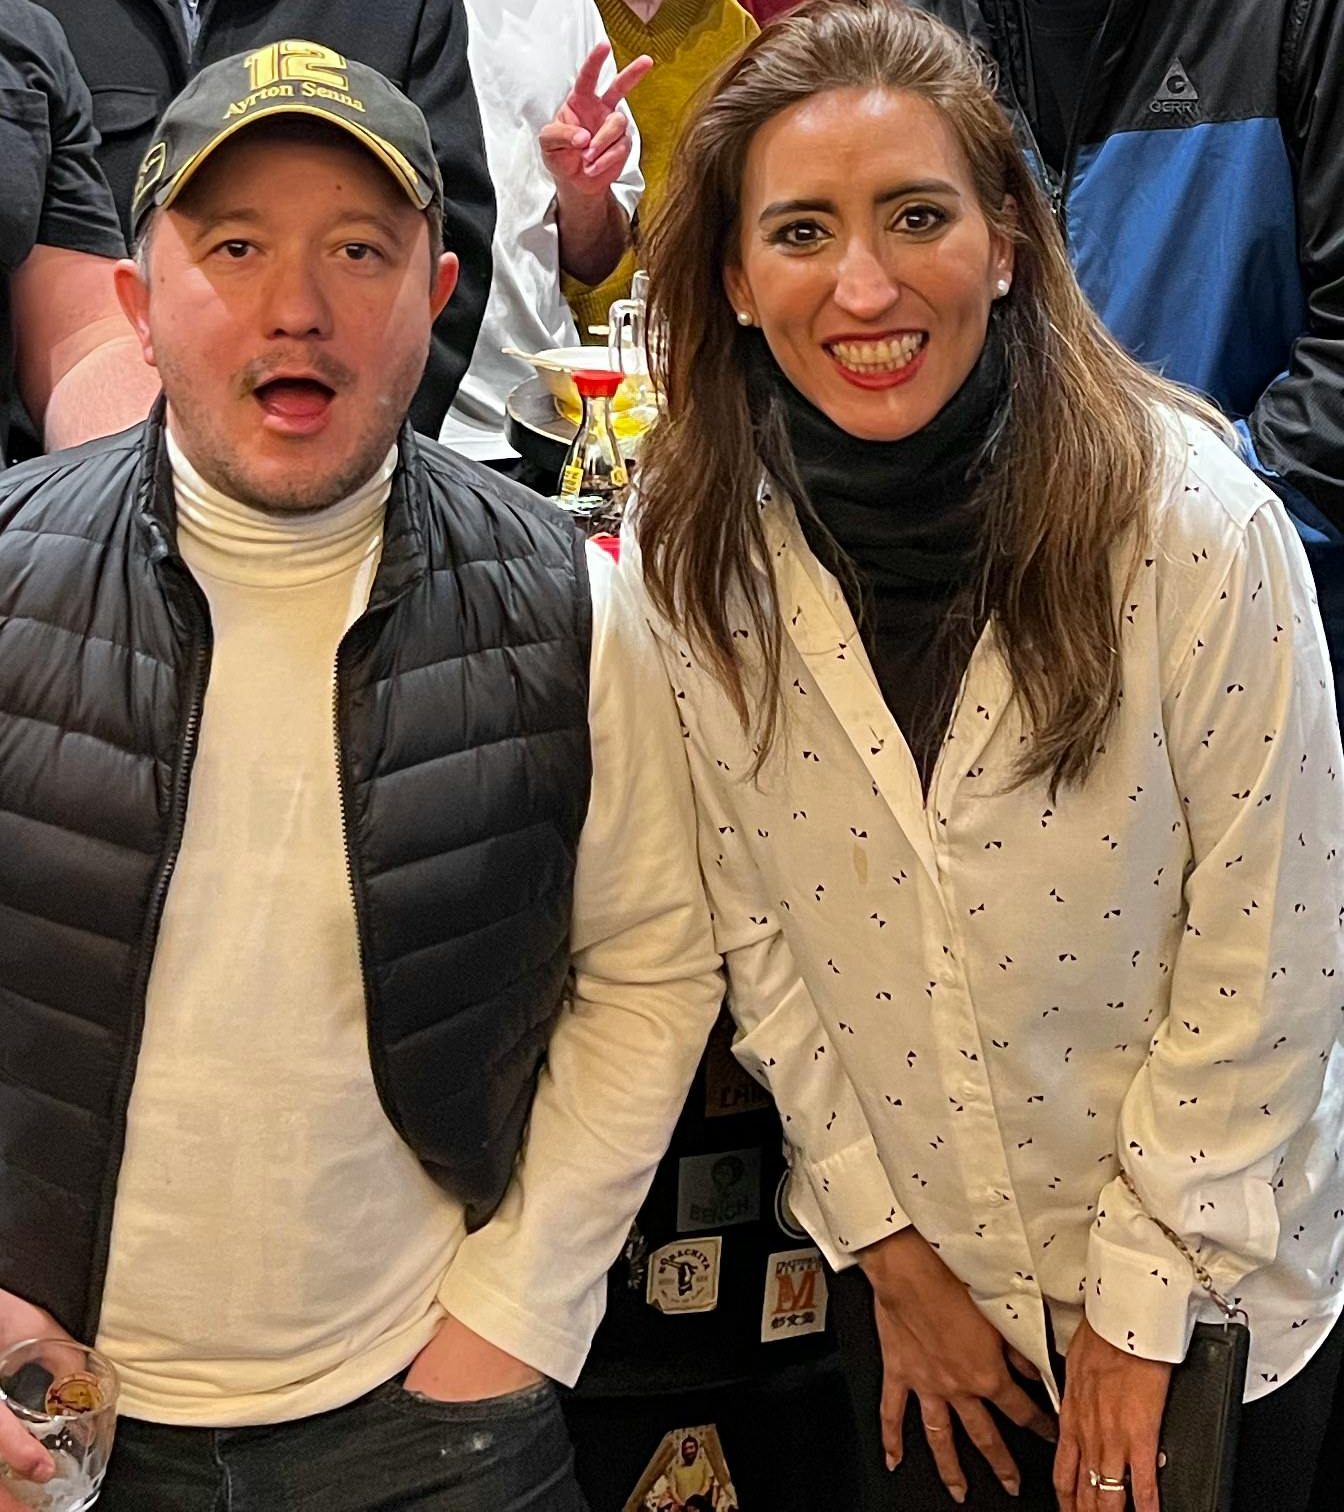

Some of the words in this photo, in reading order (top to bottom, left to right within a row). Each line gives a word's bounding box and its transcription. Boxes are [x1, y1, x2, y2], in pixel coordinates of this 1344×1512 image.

[244, 40, 350, 92] 12
[222, 82, 294, 120] Ayrton
[301, 81, 366, 113] Senna
[1149, 100, 1199, 114] GERRY
